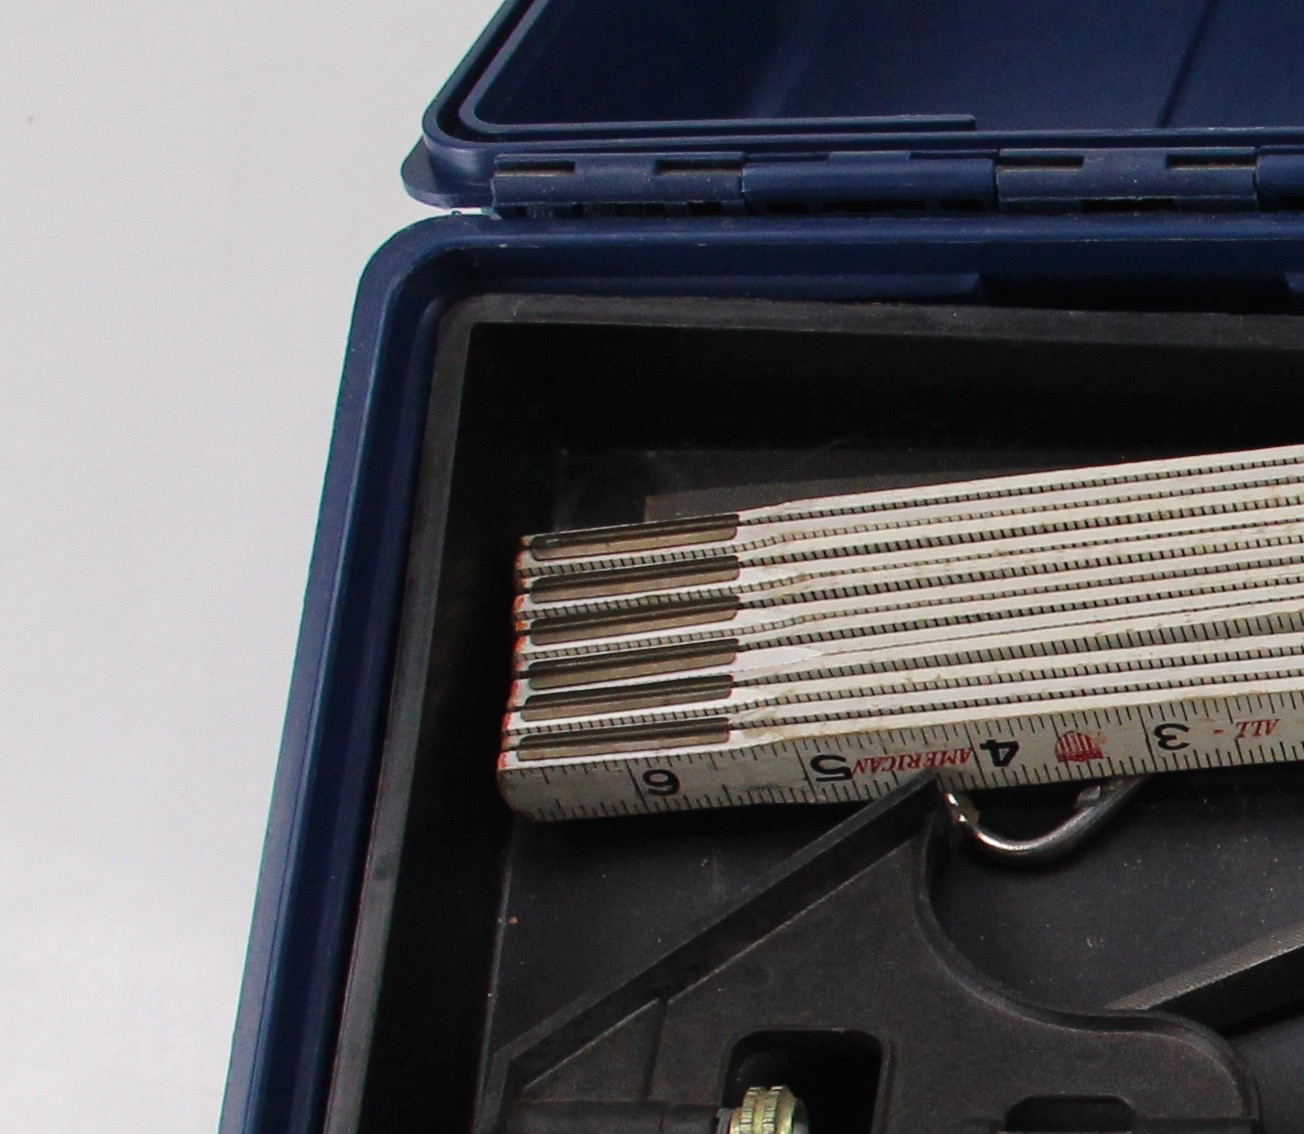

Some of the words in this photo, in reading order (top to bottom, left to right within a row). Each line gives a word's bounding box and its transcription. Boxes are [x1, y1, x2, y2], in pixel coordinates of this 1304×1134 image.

[1154, 722, 1190, 752] 3
[809, 753, 854, 783] 5
[851, 747, 975, 775] AMERICAN
[979, 739, 1021, 768] 4
[641, 768, 681, 797] 6
